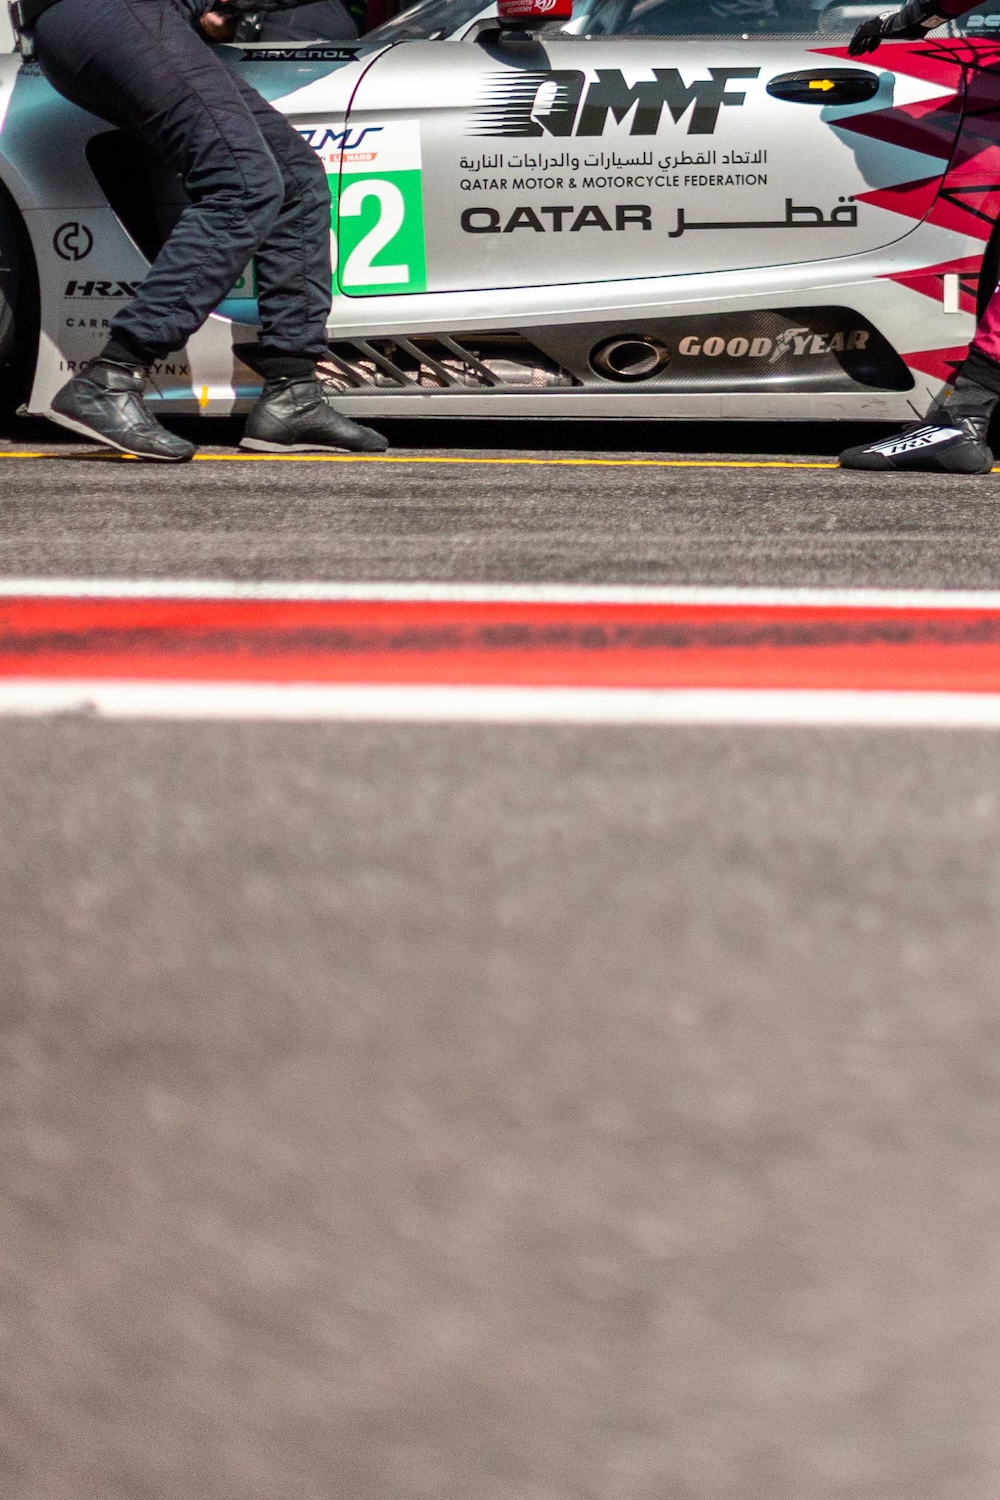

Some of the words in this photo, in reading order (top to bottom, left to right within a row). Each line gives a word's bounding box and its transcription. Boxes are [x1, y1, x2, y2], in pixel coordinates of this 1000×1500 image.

[252, 50, 350, 60] RAVENOL
[459, 153, 503, 172] النارية
[508, 153, 580, 171] والدراجات
[584, 151, 653, 170] للسيارات
[658, 150, 716, 172] القطري
[722, 149, 767, 165] الاتحاد
[460, 178, 507, 191] QATAR
[512, 177, 564, 189] MOTOR
[568, 177, 577, 189] &
[582, 175, 680, 188] MOTORCYCLE
[684, 174, 768, 187] FEDERATION
[460, 204, 652, 234] QATAR
[667, 197, 858, 238] قطر
[891, 434, 934, 454] HRX
